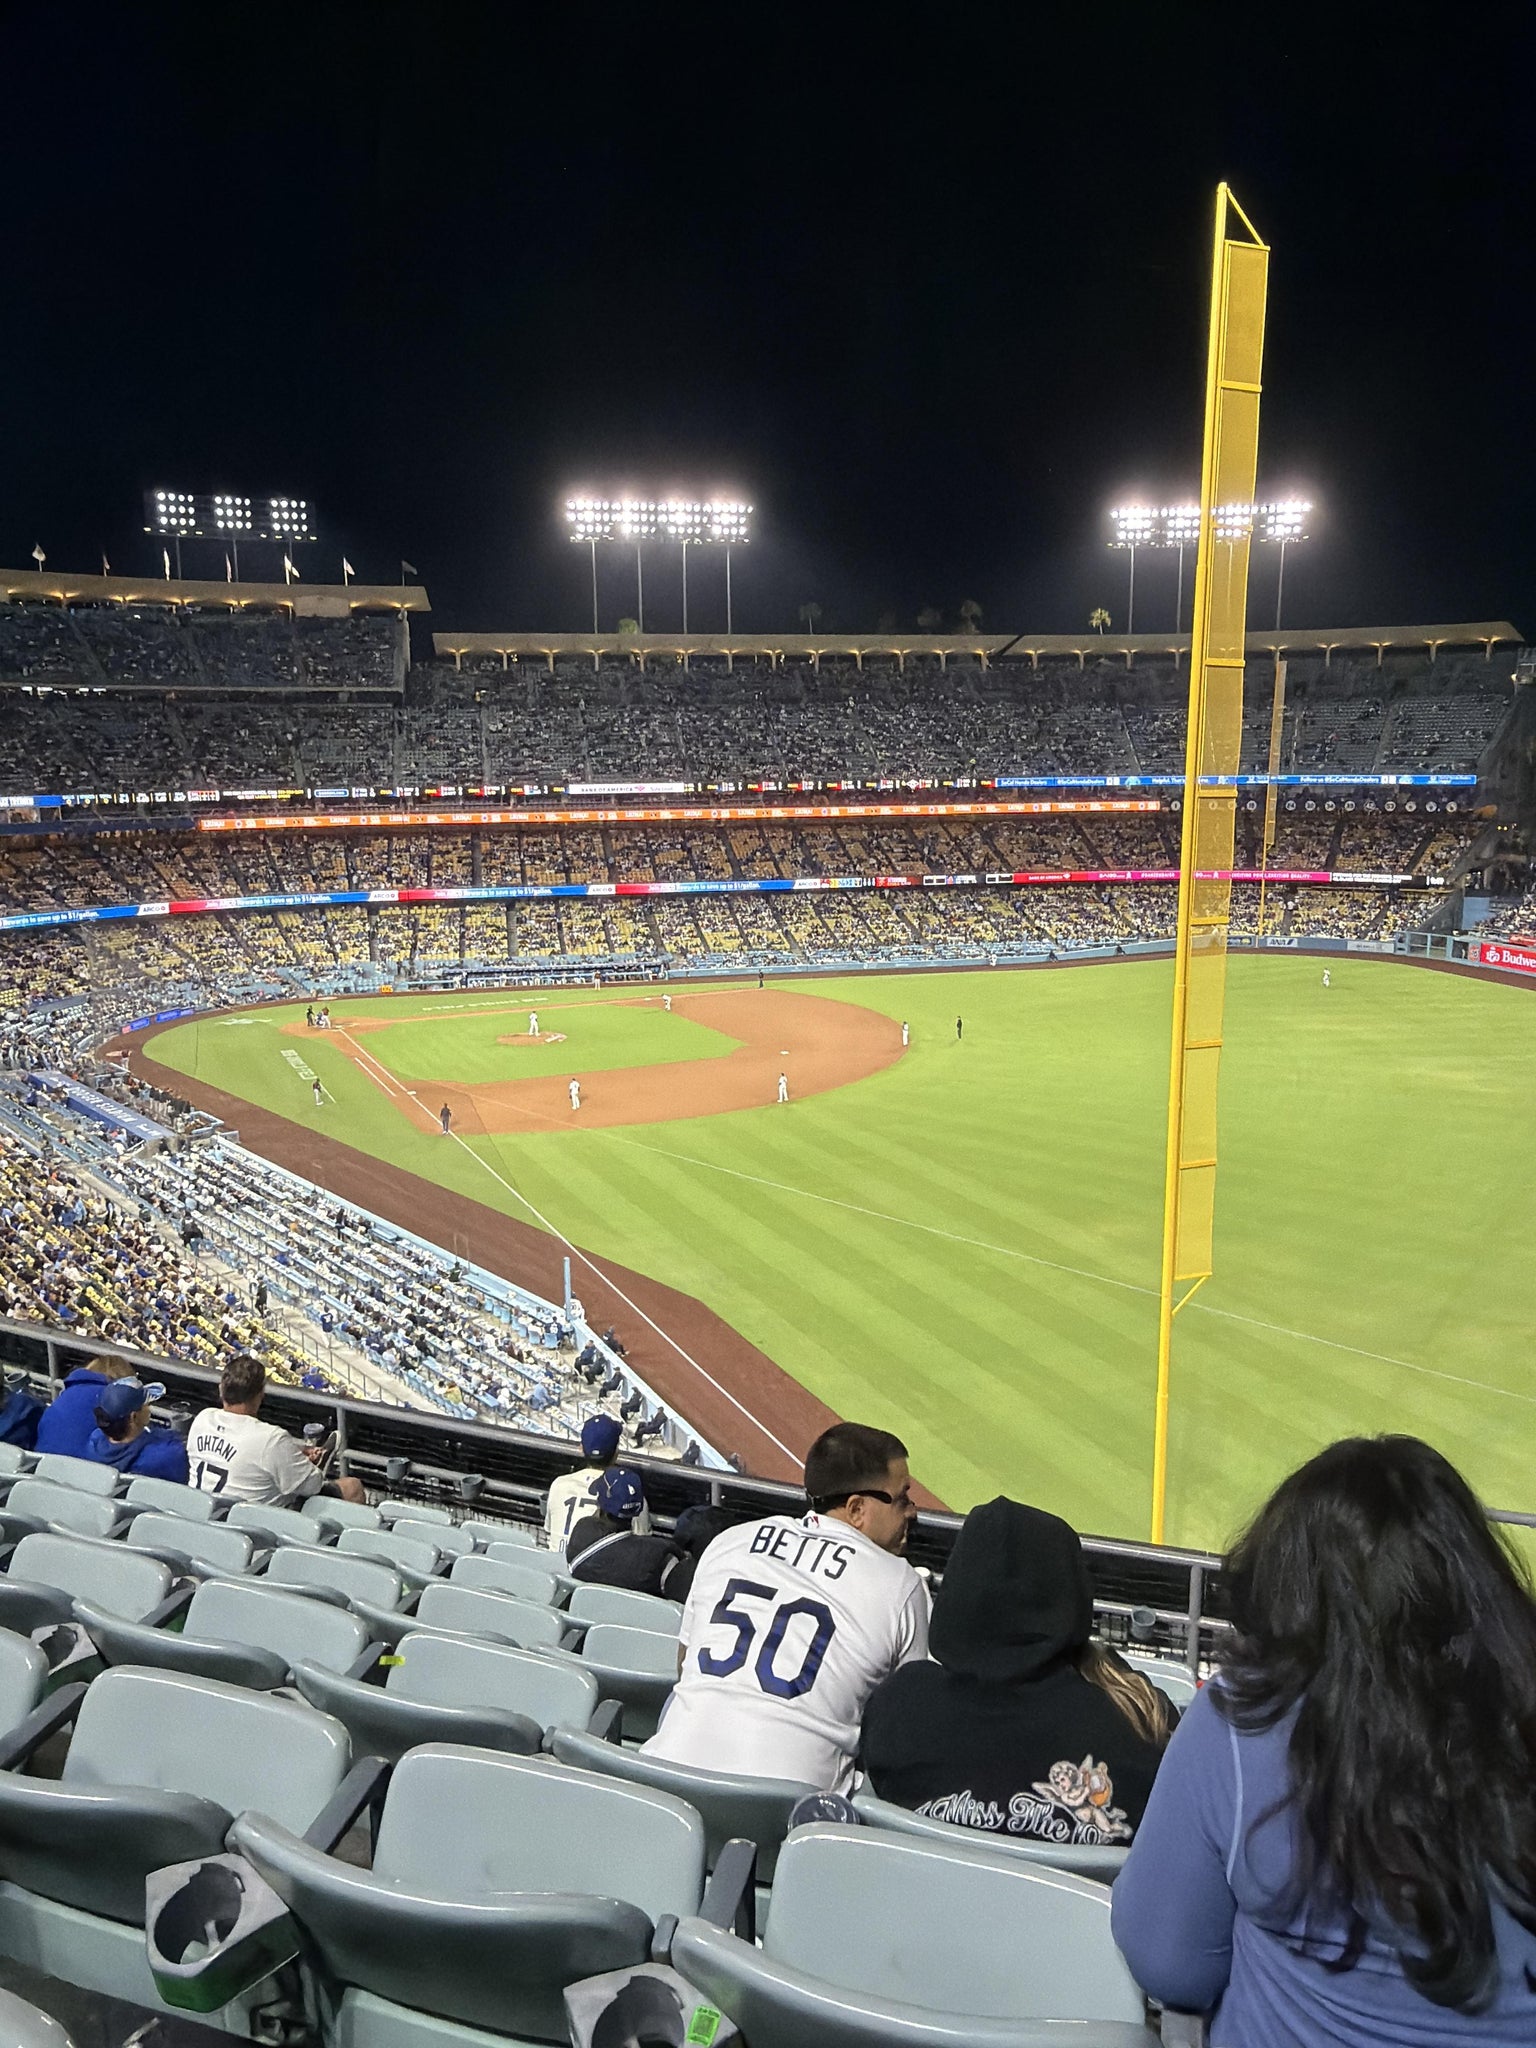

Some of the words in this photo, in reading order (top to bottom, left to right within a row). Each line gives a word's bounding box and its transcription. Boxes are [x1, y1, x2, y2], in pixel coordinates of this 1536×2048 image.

[197, 1435, 237, 1462] OHTANI
[196, 1461, 229, 1493] 17
[750, 1524, 856, 1580] BETTS
[697, 1577, 837, 1700] 50
[1007, 1792, 1073, 1842] The
